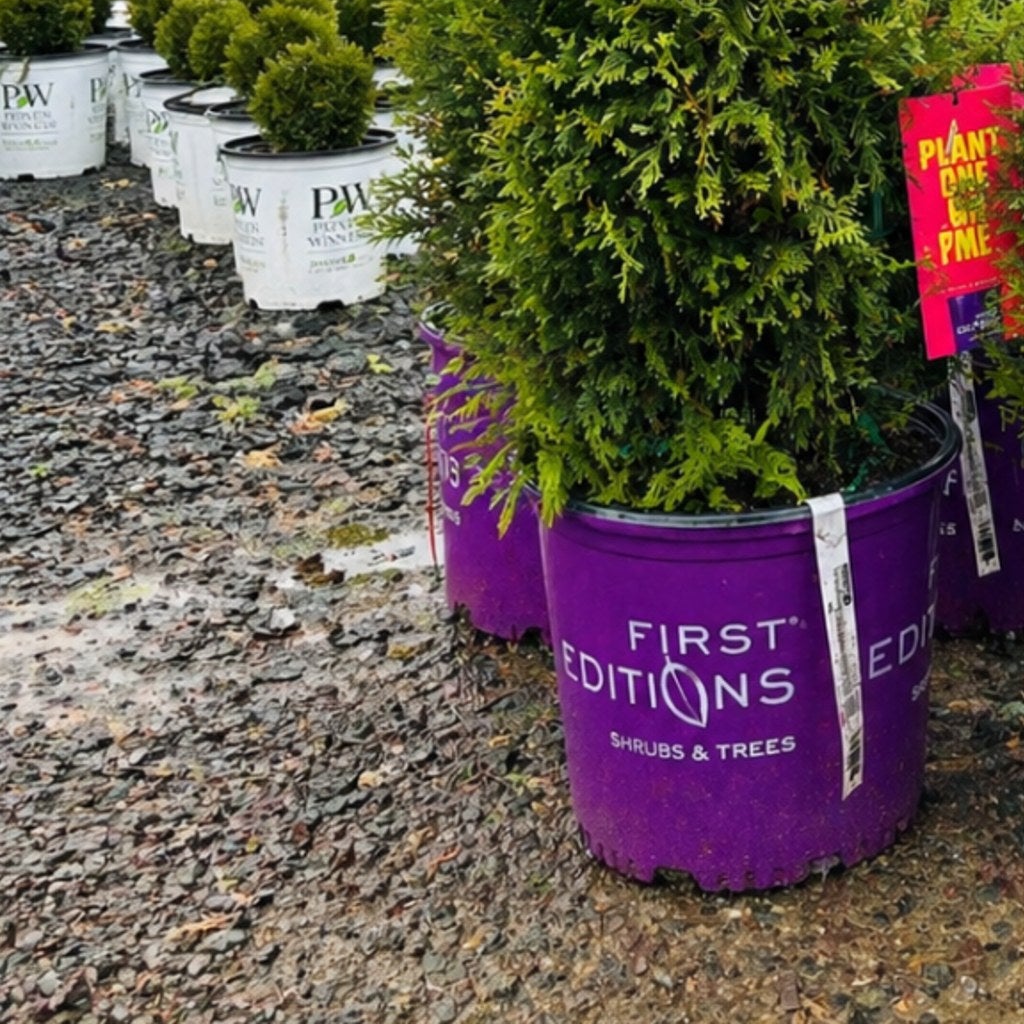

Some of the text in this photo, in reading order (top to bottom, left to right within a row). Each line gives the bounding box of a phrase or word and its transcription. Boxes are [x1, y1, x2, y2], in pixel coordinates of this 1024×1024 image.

[3, 82, 54, 110] PW
[918, 126, 1000, 170] PLANT
[311, 182, 370, 220] PW
[561, 639, 795, 728] EDITIONS
[610, 730, 797, 761] SHRUBS & TREES
